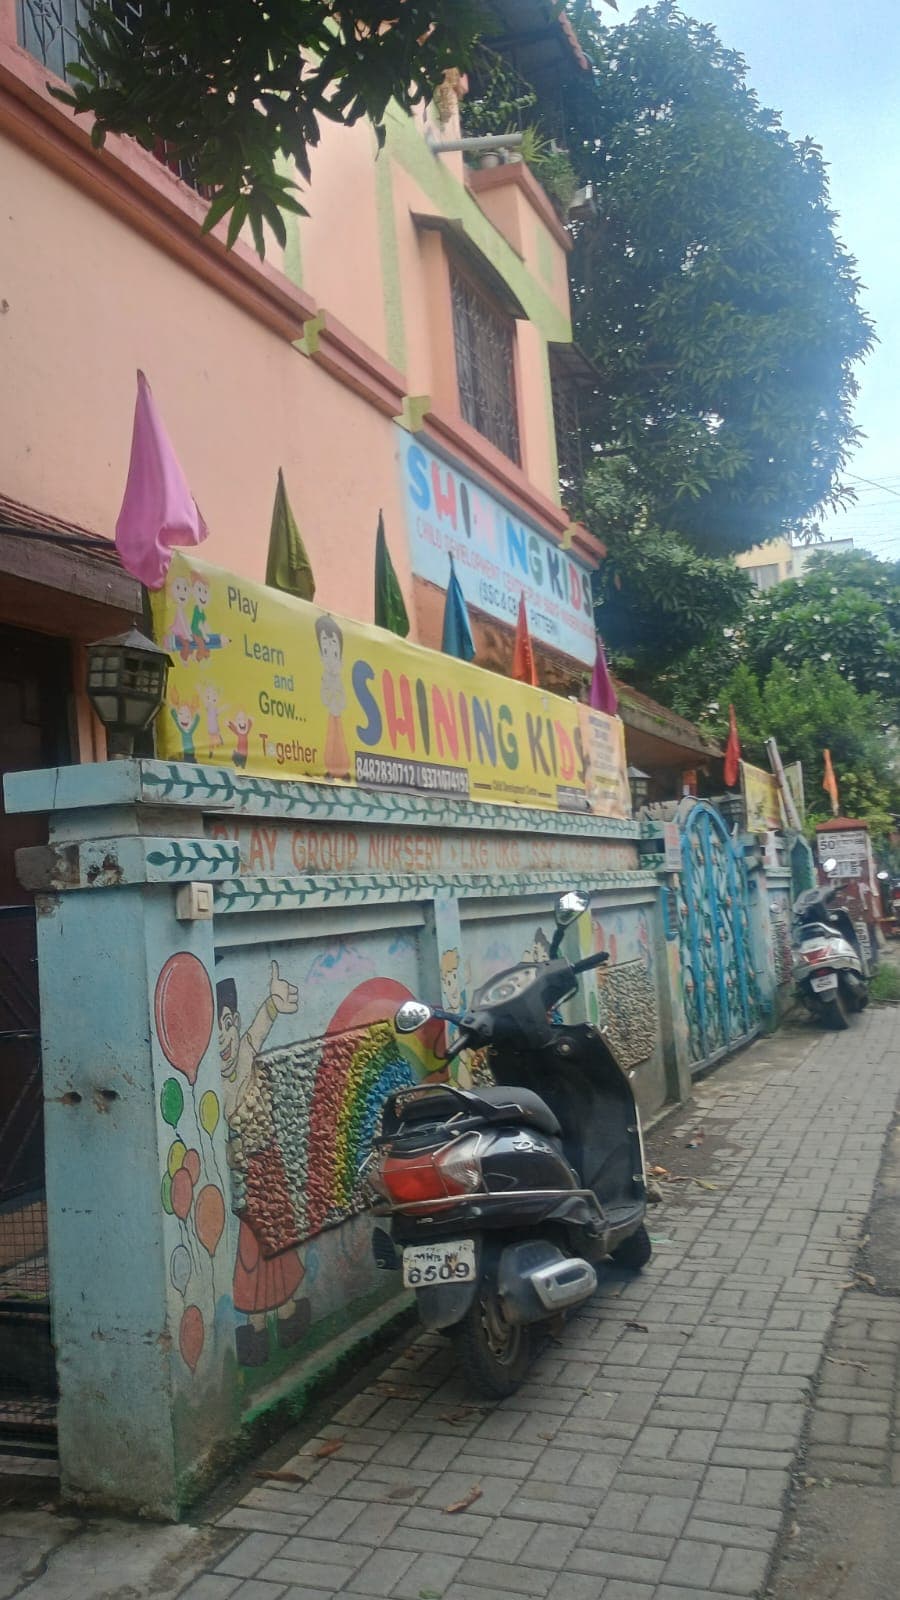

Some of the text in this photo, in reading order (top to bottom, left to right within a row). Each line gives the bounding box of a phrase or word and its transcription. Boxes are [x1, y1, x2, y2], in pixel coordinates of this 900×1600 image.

[547, 547, 592, 618] KIDS
[228, 586, 258, 623] Play
[244, 634, 285, 667] Learn
[274, 675, 294, 692] and
[259, 691, 307, 723] Grow...
[352, 660, 519, 770] SHINING
[356, 757, 415, 785] 8482830712
[291, 830, 358, 871] GROUP
[368, 832, 442, 871] NURSERY
[408, 1262, 470, 1284] 6509
